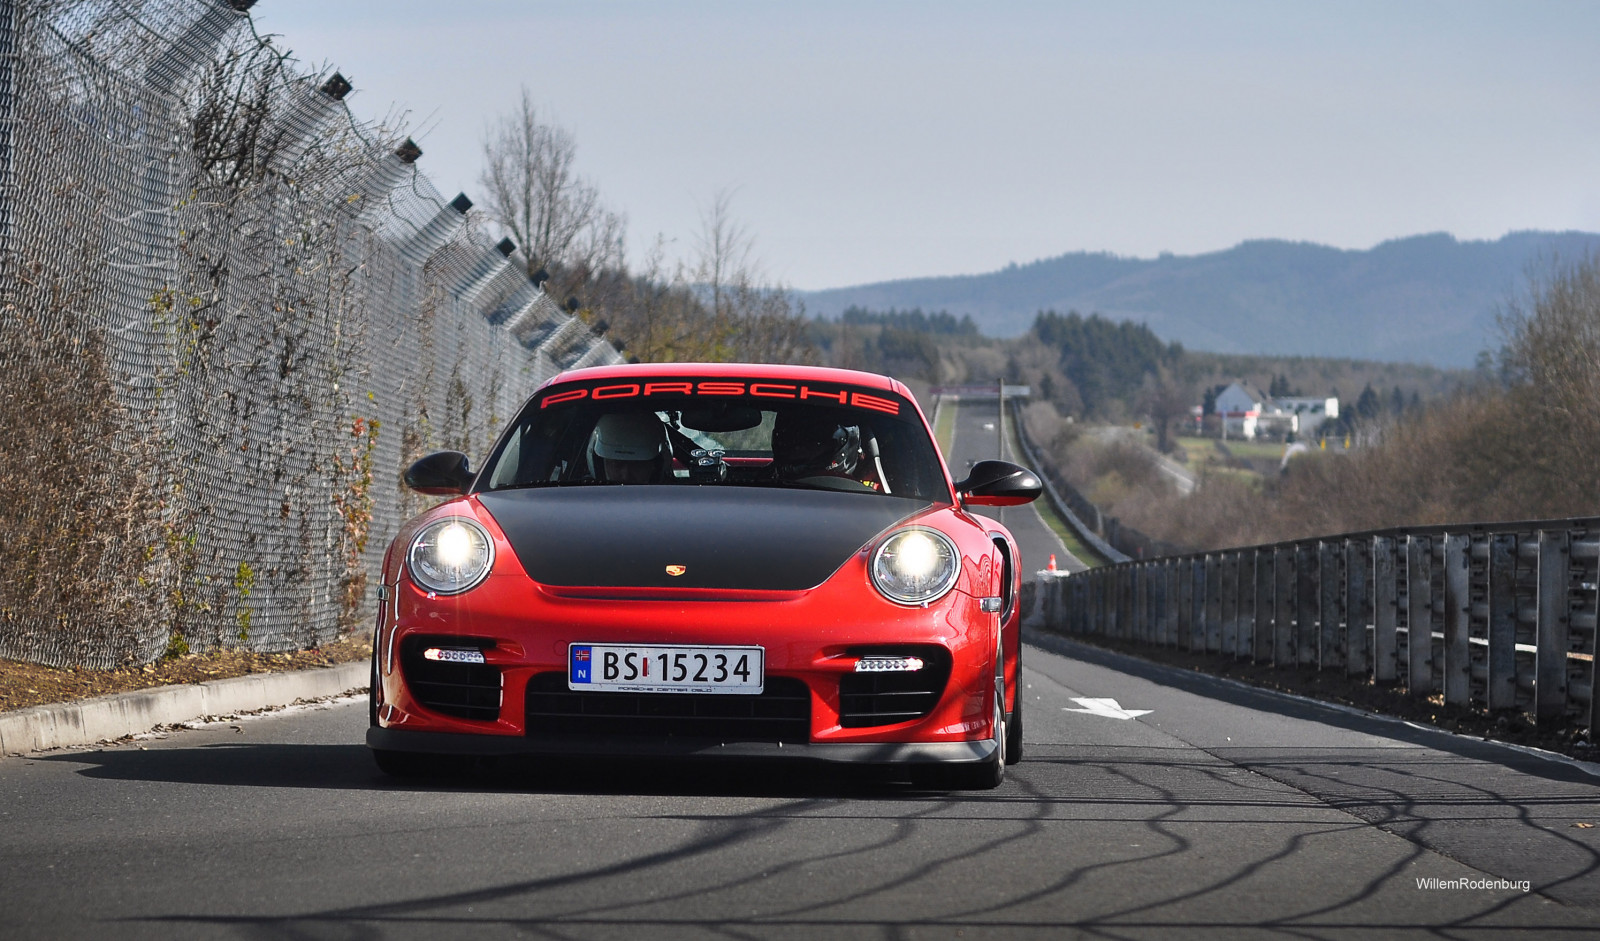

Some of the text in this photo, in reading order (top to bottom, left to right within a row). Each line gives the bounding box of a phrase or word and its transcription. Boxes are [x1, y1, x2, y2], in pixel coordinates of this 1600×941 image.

[540, 382, 900, 415] PORSCHE
[577, 669, 587, 679] N
[603, 652, 751, 683] BS 15234
